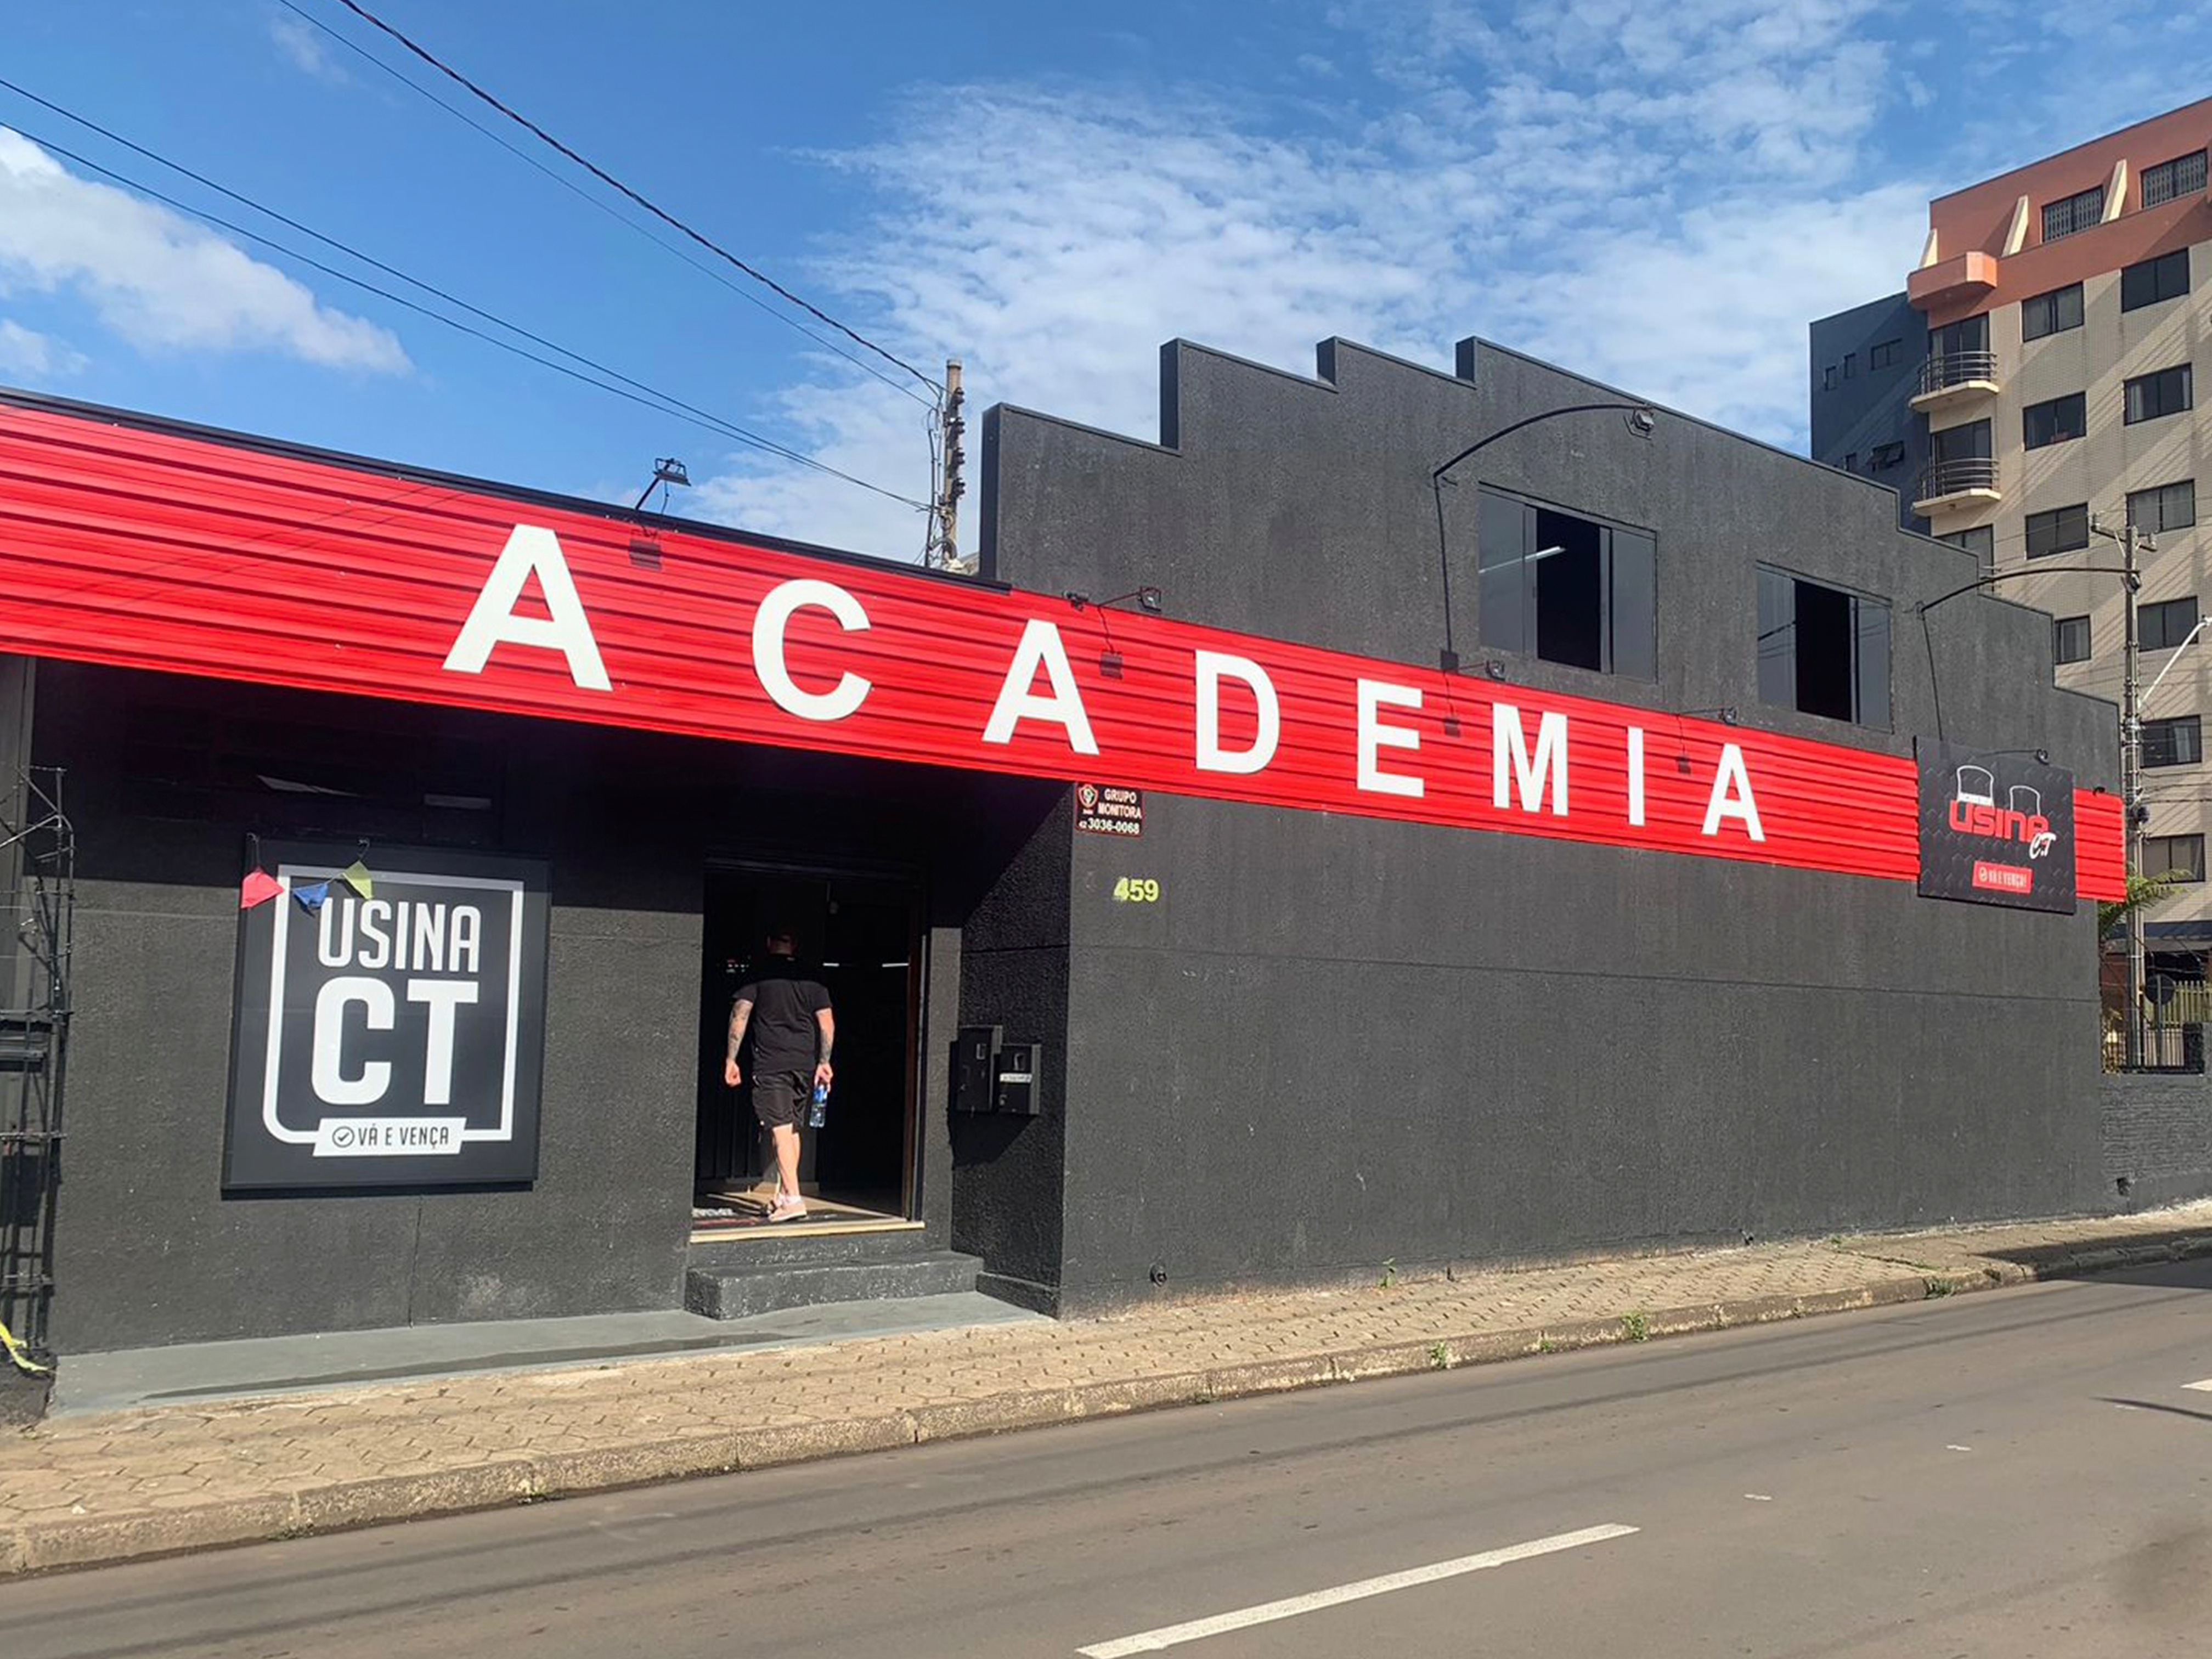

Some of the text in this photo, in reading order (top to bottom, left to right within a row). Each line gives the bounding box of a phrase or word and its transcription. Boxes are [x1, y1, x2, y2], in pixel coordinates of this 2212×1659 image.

[442, 523, 1765, 842] ACADEMIA
[1104, 789, 1137, 804] GRUPO
[1098, 803, 1142, 819] MONITORA
[1114, 877, 1159, 901] 459
[318, 897, 481, 972] USINA
[311, 977, 478, 1105] CT
[358, 1123, 449, 1150] VÁ E VENÇA
